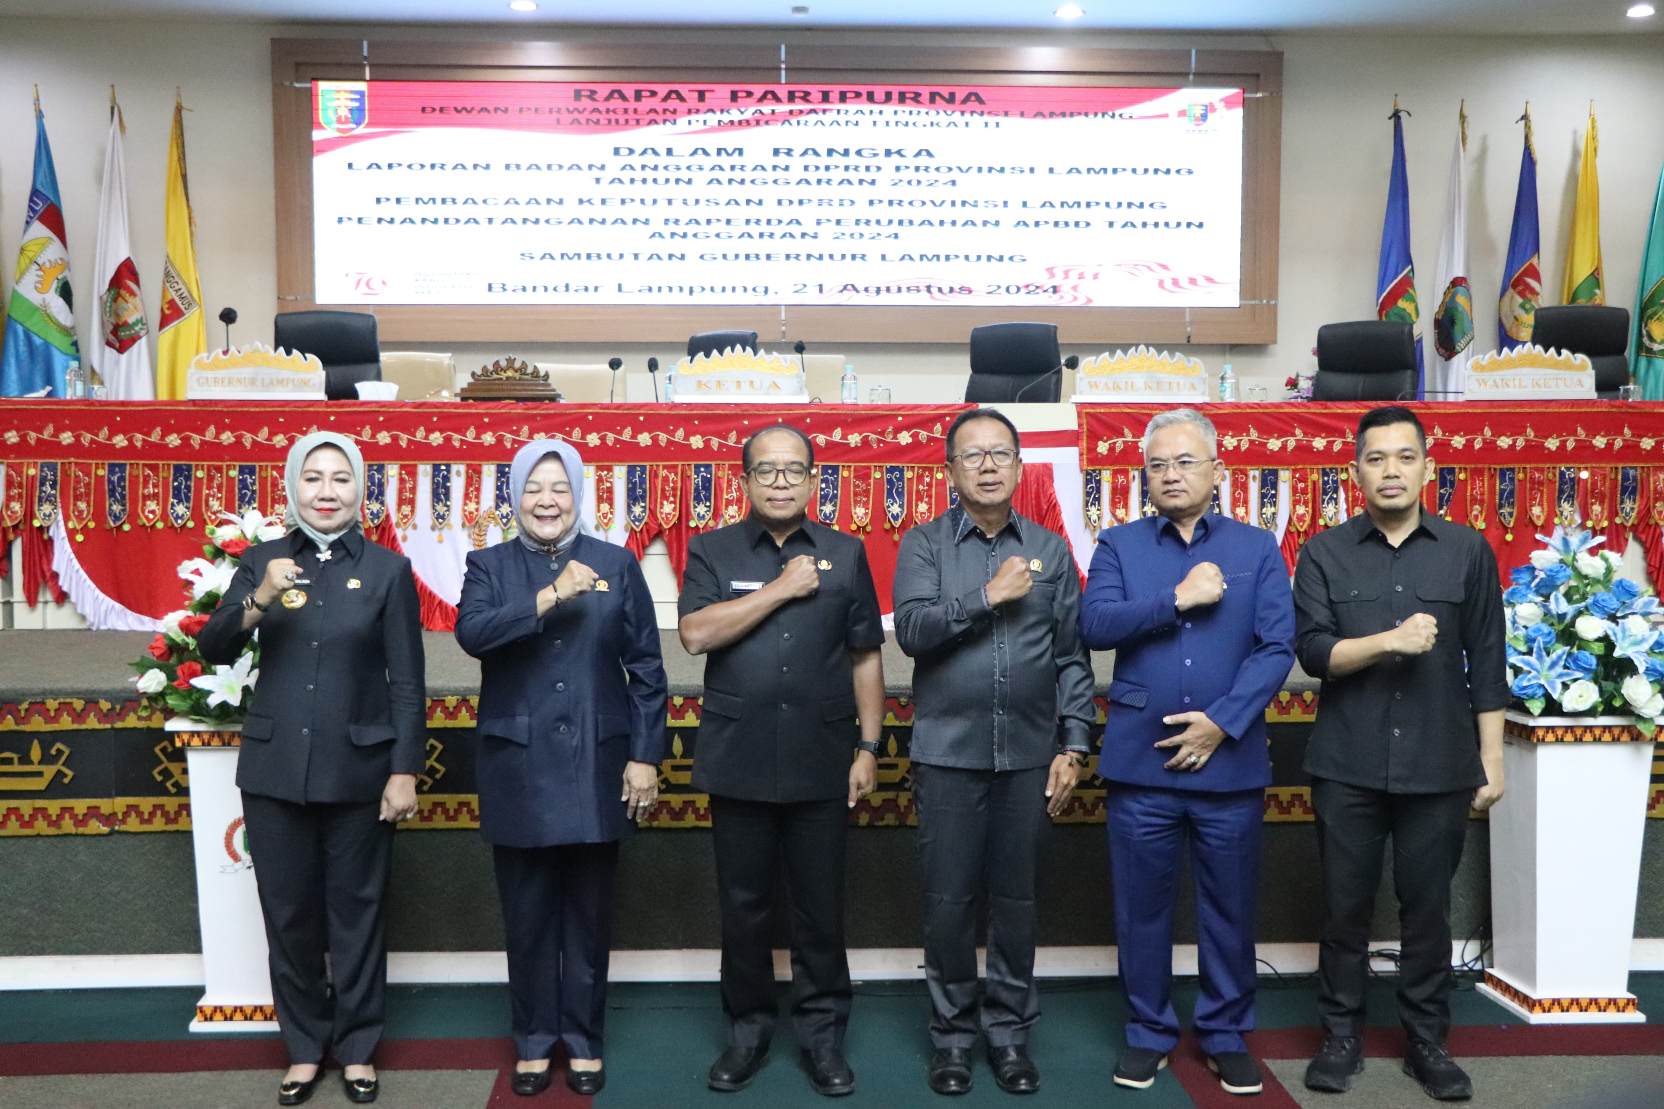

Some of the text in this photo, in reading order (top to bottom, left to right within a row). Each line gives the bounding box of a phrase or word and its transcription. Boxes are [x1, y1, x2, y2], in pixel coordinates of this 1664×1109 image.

[573, 88, 987, 106] RAPAT PARIPURNA
[420, 105, 510, 115] DEWAN
[517, 106, 678, 115] PERWAKILAN
[1019, 111, 1135, 120] LAMPUNG
[556, 117, 678, 126] LANJUTAN
[613, 147, 935, 158] DALAM RANGKA
[347, 162, 1195, 176] LAPORAN BADAN ANGGARAN DPRD PROVINSI LAMPUNG
[591, 177, 958, 188] TAHUN ANGGARAN 2024
[375, 196, 1168, 210] PEMBACAAN KEPUTUSAN DPRD PROVINSI LAMPUNG
[337, 216, 1205, 230] PENANDATANGANAN RAPERDA PERUBAHAN APBD TAHUN
[648, 231, 900, 241] ANGGARAN 2024
[519, 252, 1028, 264] SAMBUTAN GUBERNUR LAMPUNG
[487, 282, 603, 293] Bandar
[792, 283, 824, 294] 21
[839, 282, 973, 297] Agustus
[986, 284, 1059, 295] 2024
[696, 379, 782, 392] KETUA
[1087, 380, 1137, 392] WAKIL
[1476, 376, 1585, 389] WAKIL KETUA
